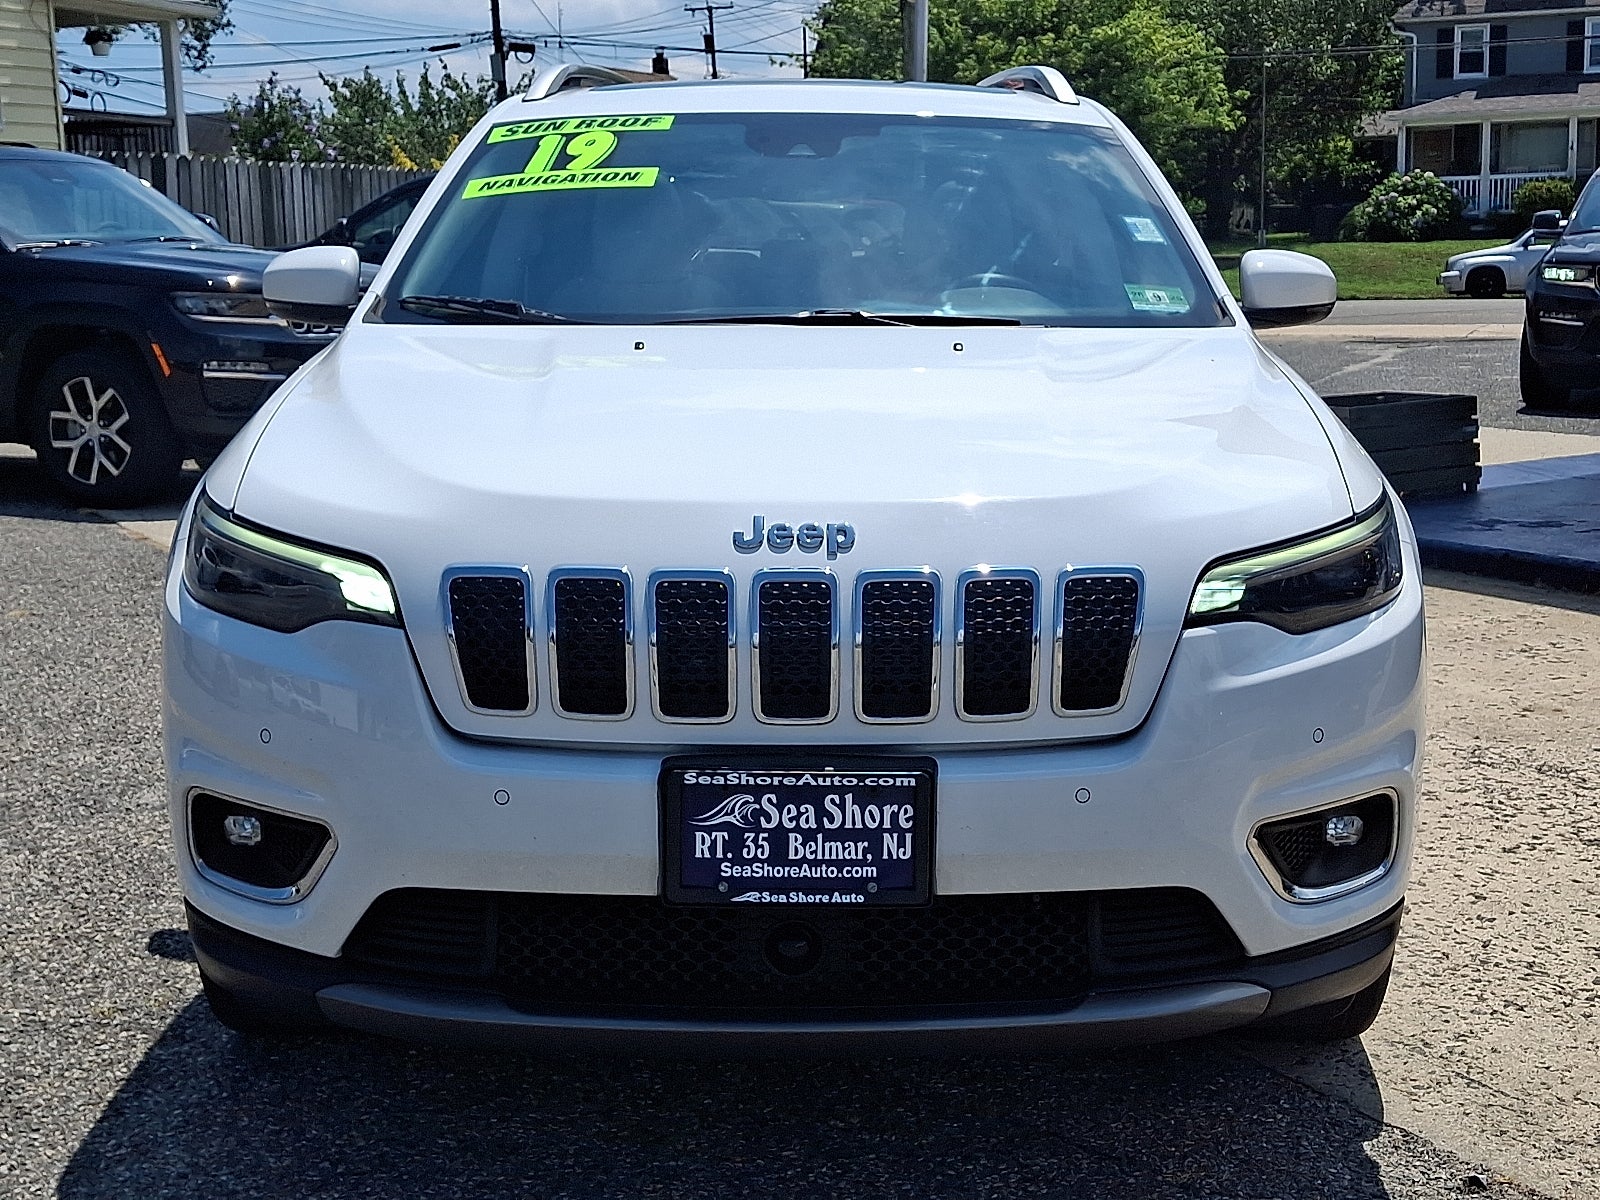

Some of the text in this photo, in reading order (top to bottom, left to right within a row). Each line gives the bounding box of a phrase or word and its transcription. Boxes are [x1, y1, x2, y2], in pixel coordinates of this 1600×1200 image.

[500, 116, 665, 138] SUN ROOF
[523, 130, 618, 174] 19
[477, 170, 643, 192] NAVIGATION
[733, 515, 856, 560] Jeep
[683, 773, 916, 787] SeaShoreAuto.com
[760, 793, 914, 829] Sea Shore
[694, 831, 912, 863] RT. 35 Belmar, NJ
[720, 862, 877, 878] SeaShoreAuto.com
[760, 891, 865, 903] Sea Shore Auto
